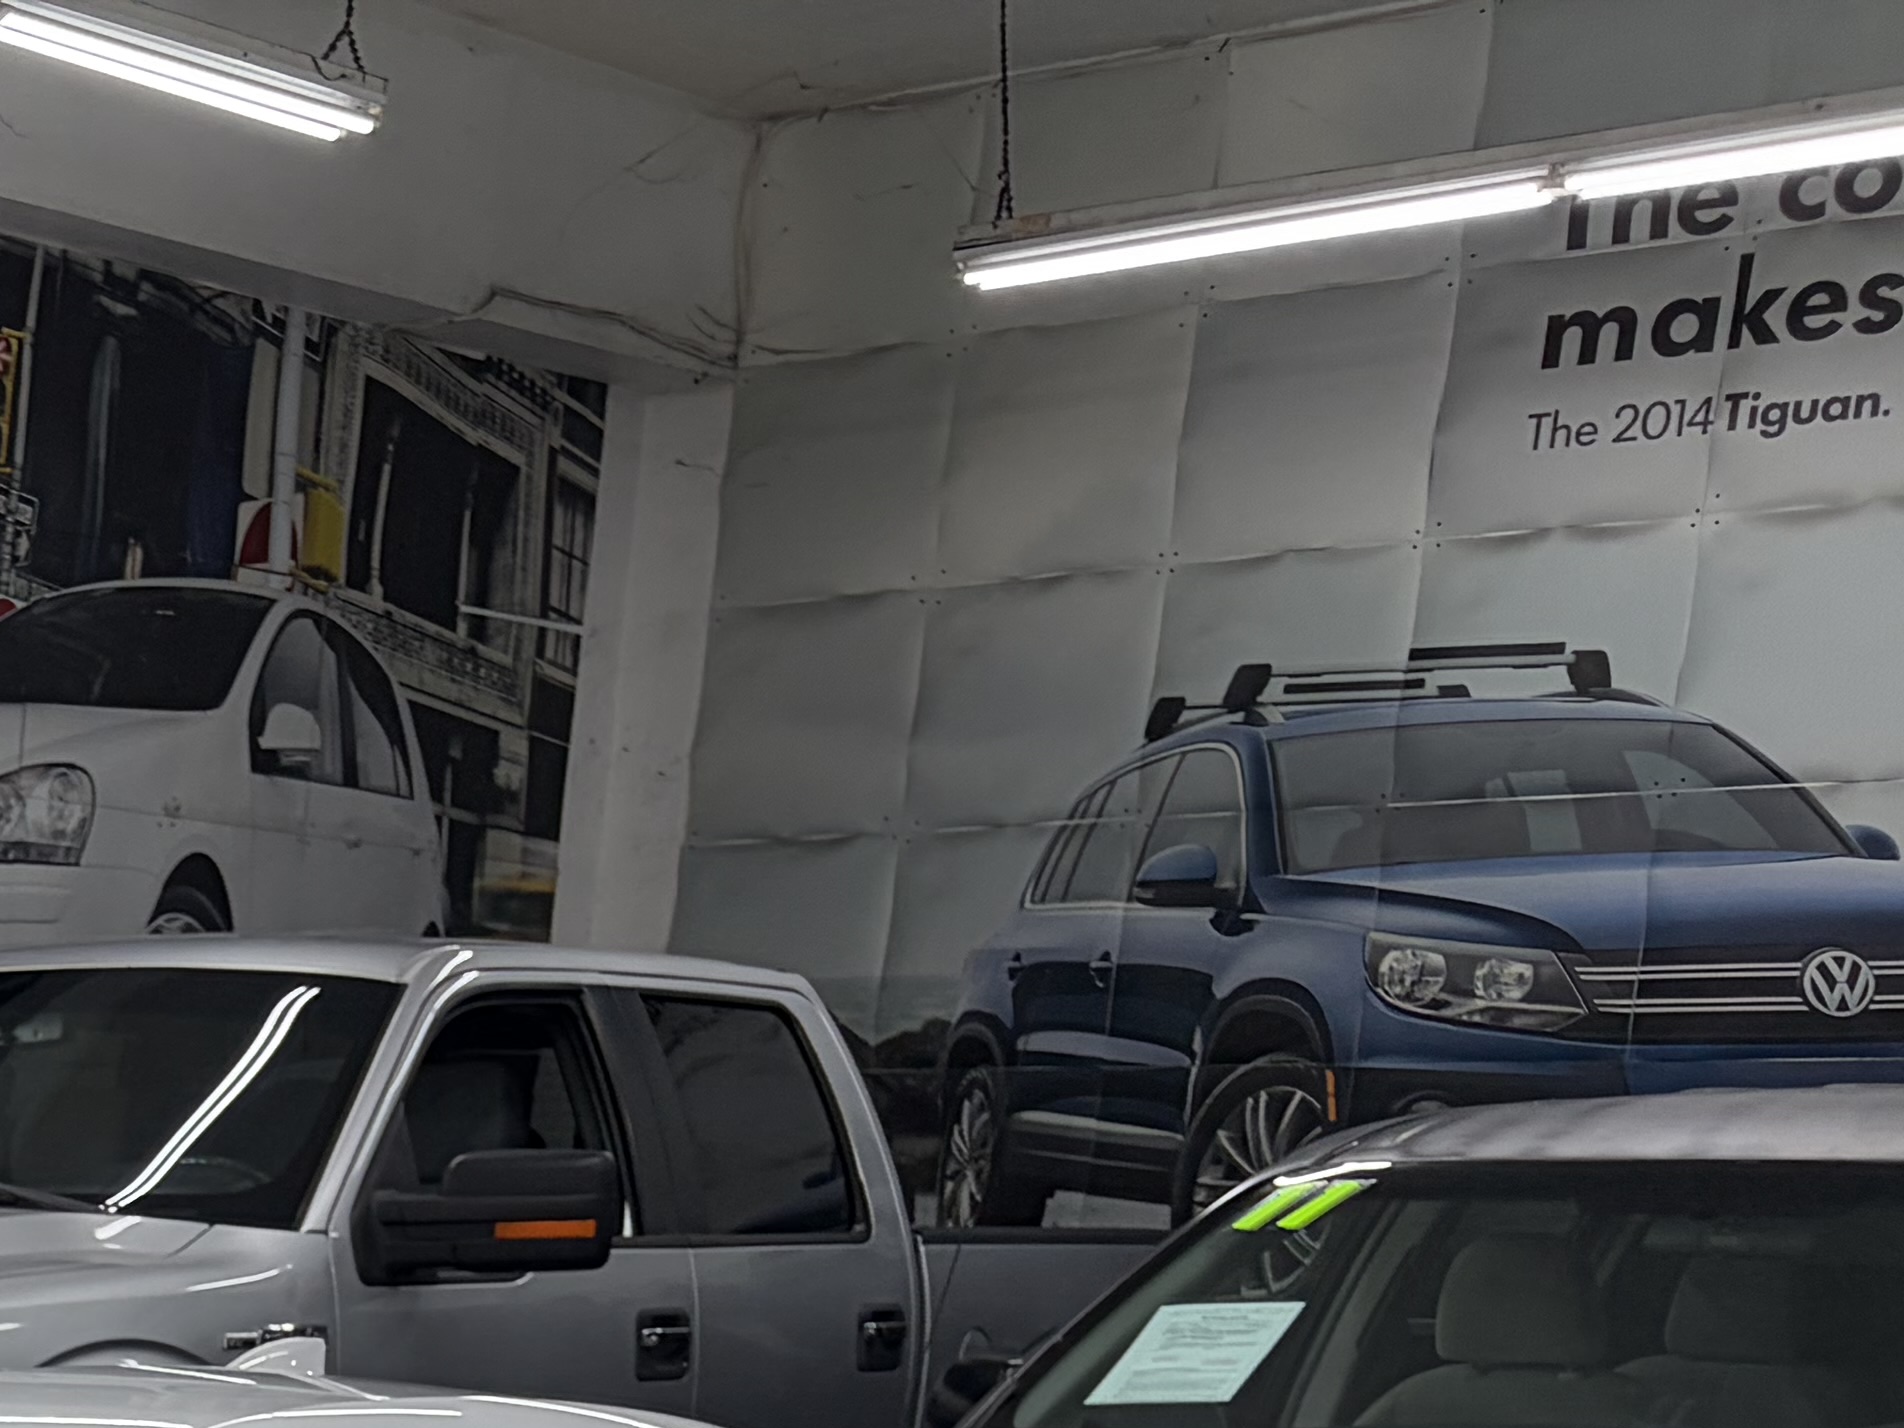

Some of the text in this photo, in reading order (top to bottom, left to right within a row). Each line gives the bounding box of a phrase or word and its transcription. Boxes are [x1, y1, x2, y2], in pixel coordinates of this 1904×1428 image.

[1541, 252, 1904, 369] makes
[1528, 391, 1891, 451] The 2014 Tiguan.
